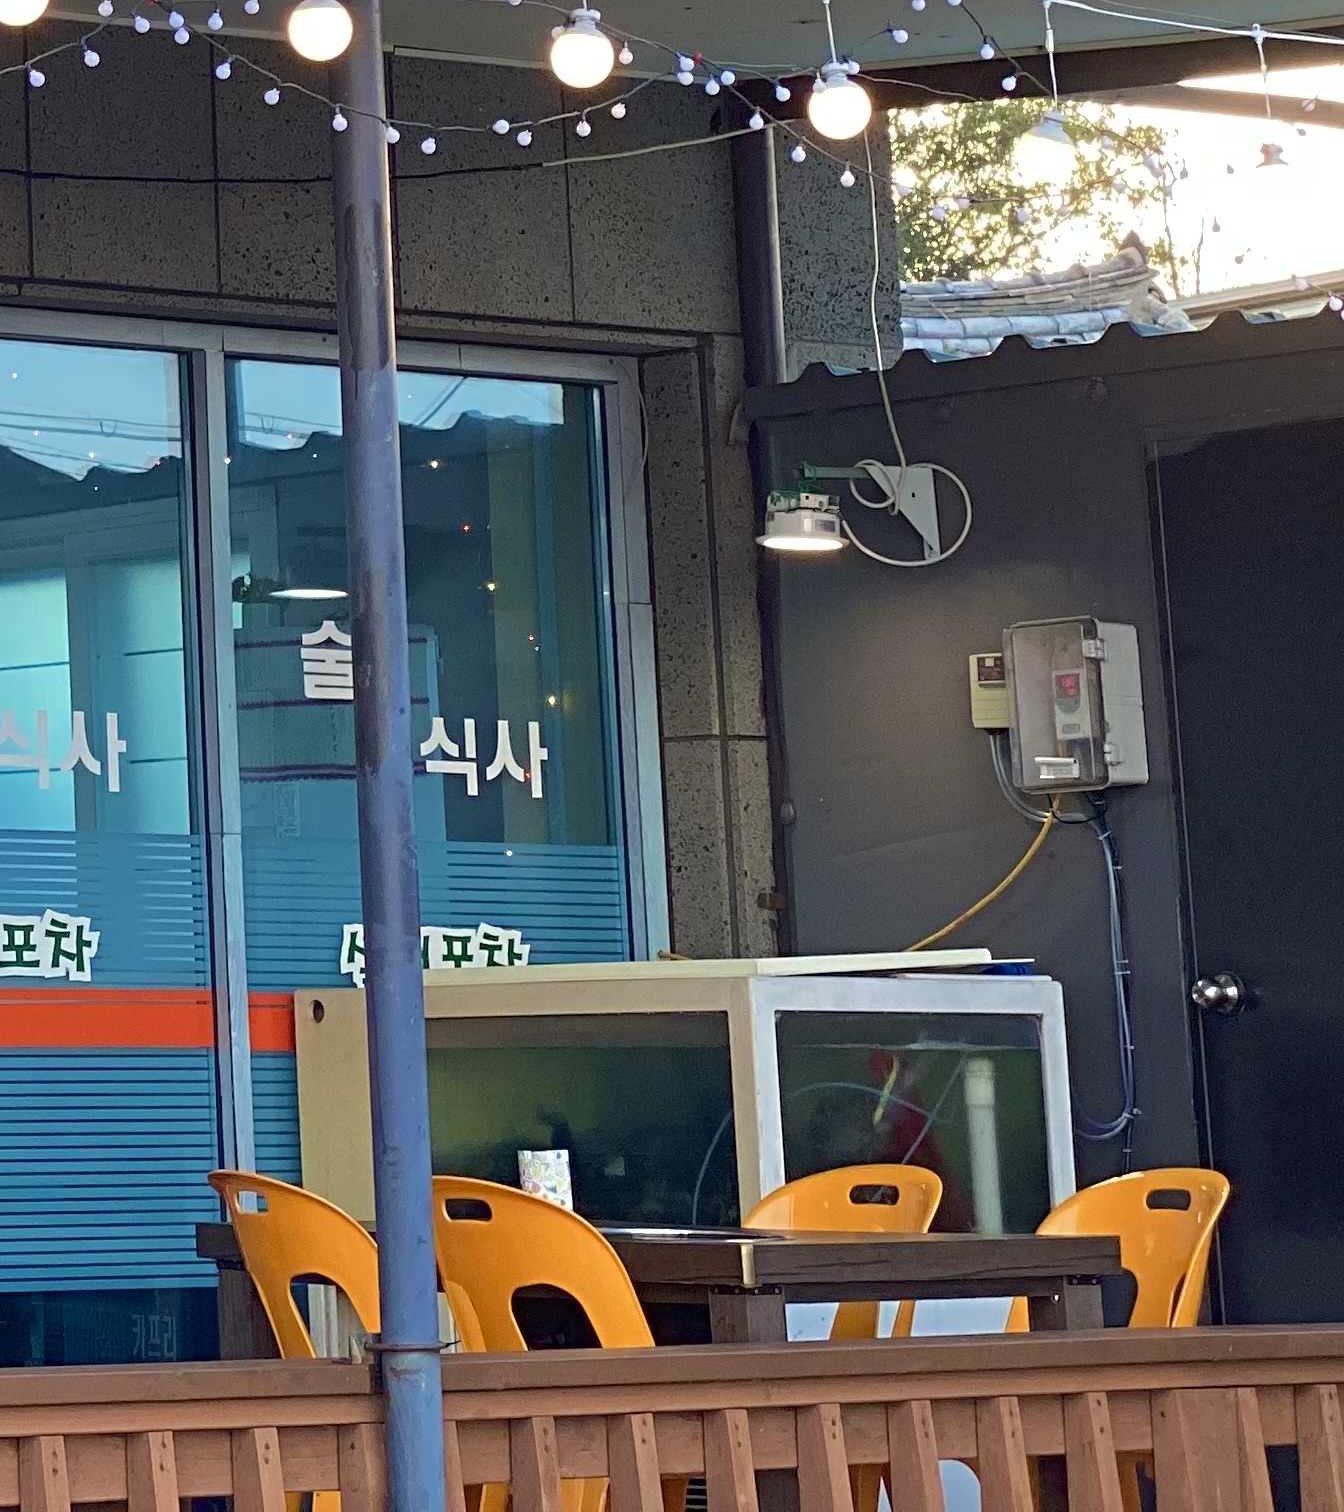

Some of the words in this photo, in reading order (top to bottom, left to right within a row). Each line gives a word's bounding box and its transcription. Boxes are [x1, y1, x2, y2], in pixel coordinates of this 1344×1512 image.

[300, 620, 355, 701] 술
[420, 717, 549, 799] 식사
[346, 929, 524, 968] 포차
